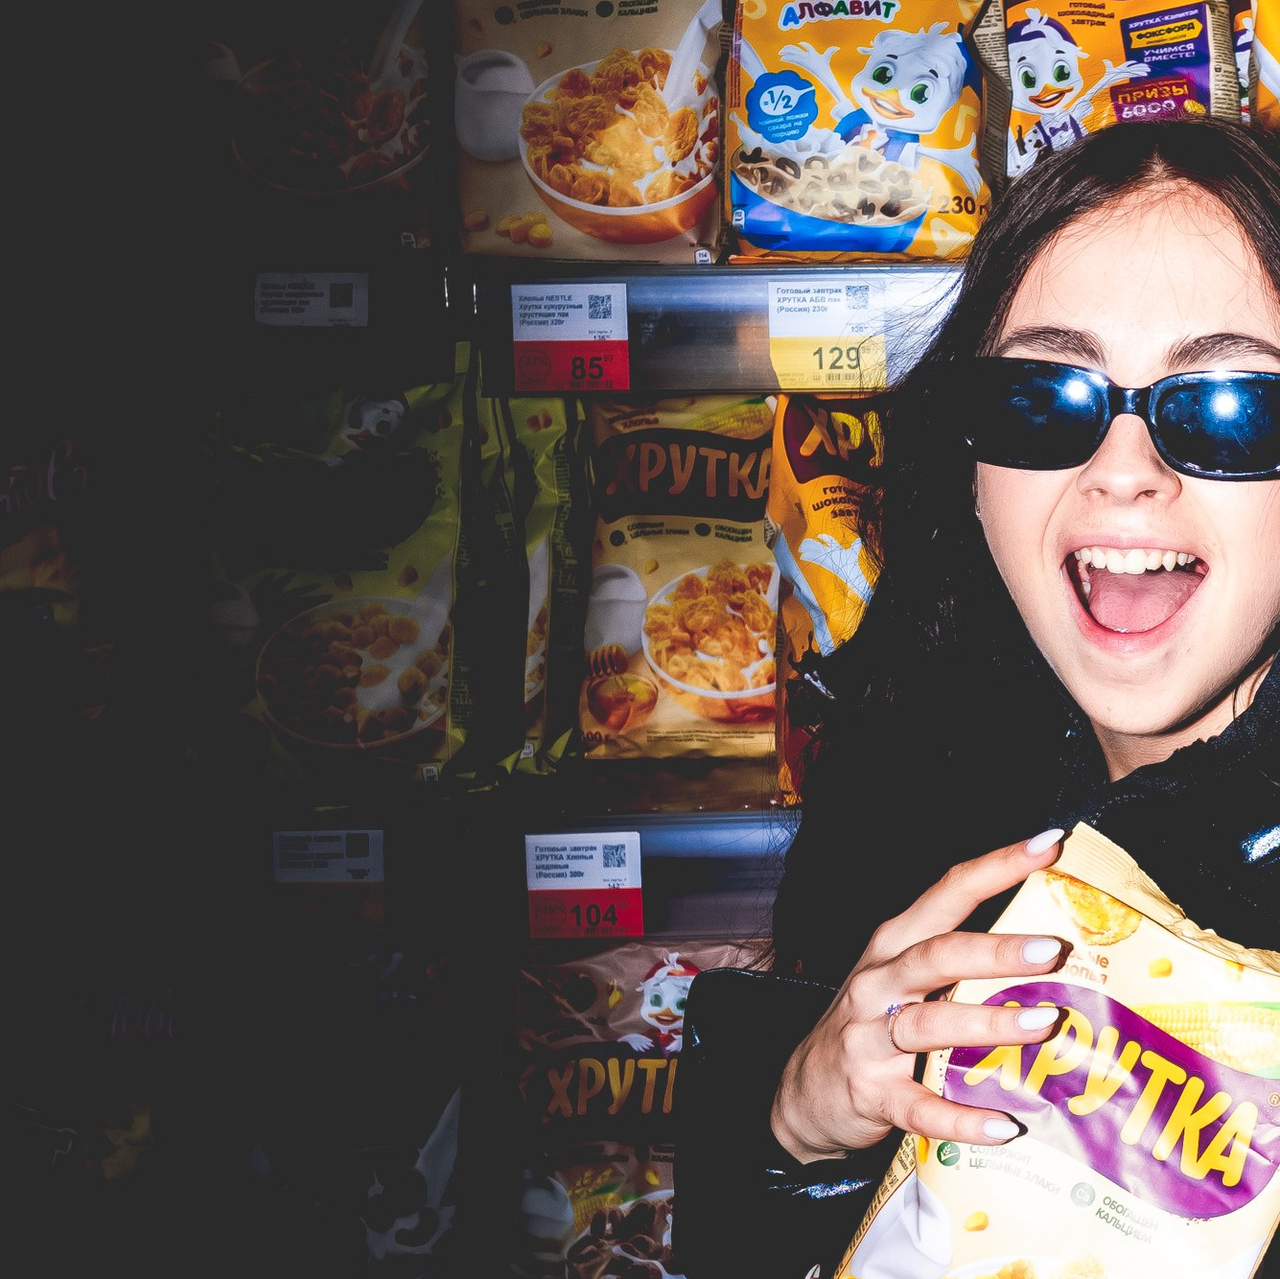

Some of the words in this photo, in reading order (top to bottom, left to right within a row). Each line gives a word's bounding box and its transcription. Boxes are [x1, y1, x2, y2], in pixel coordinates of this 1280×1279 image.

[782, 0, 896, 26] АЛФАВИТ
[1136, 22, 1195, 40] ФОКСФОРД
[1143, 43, 1195, 56] УЧИМСЯ
[1143, 51, 1195, 63] ВМЕСТЕ!
[1118, 83, 1189, 104] ПРИЗЫ
[937, 196, 976, 216] 230
[571, 356, 603, 379] 85
[813, 347, 859, 370] 129
[571, 904, 618, 927] 104
[963, 1000, 1259, 1187] ХРУТКА
